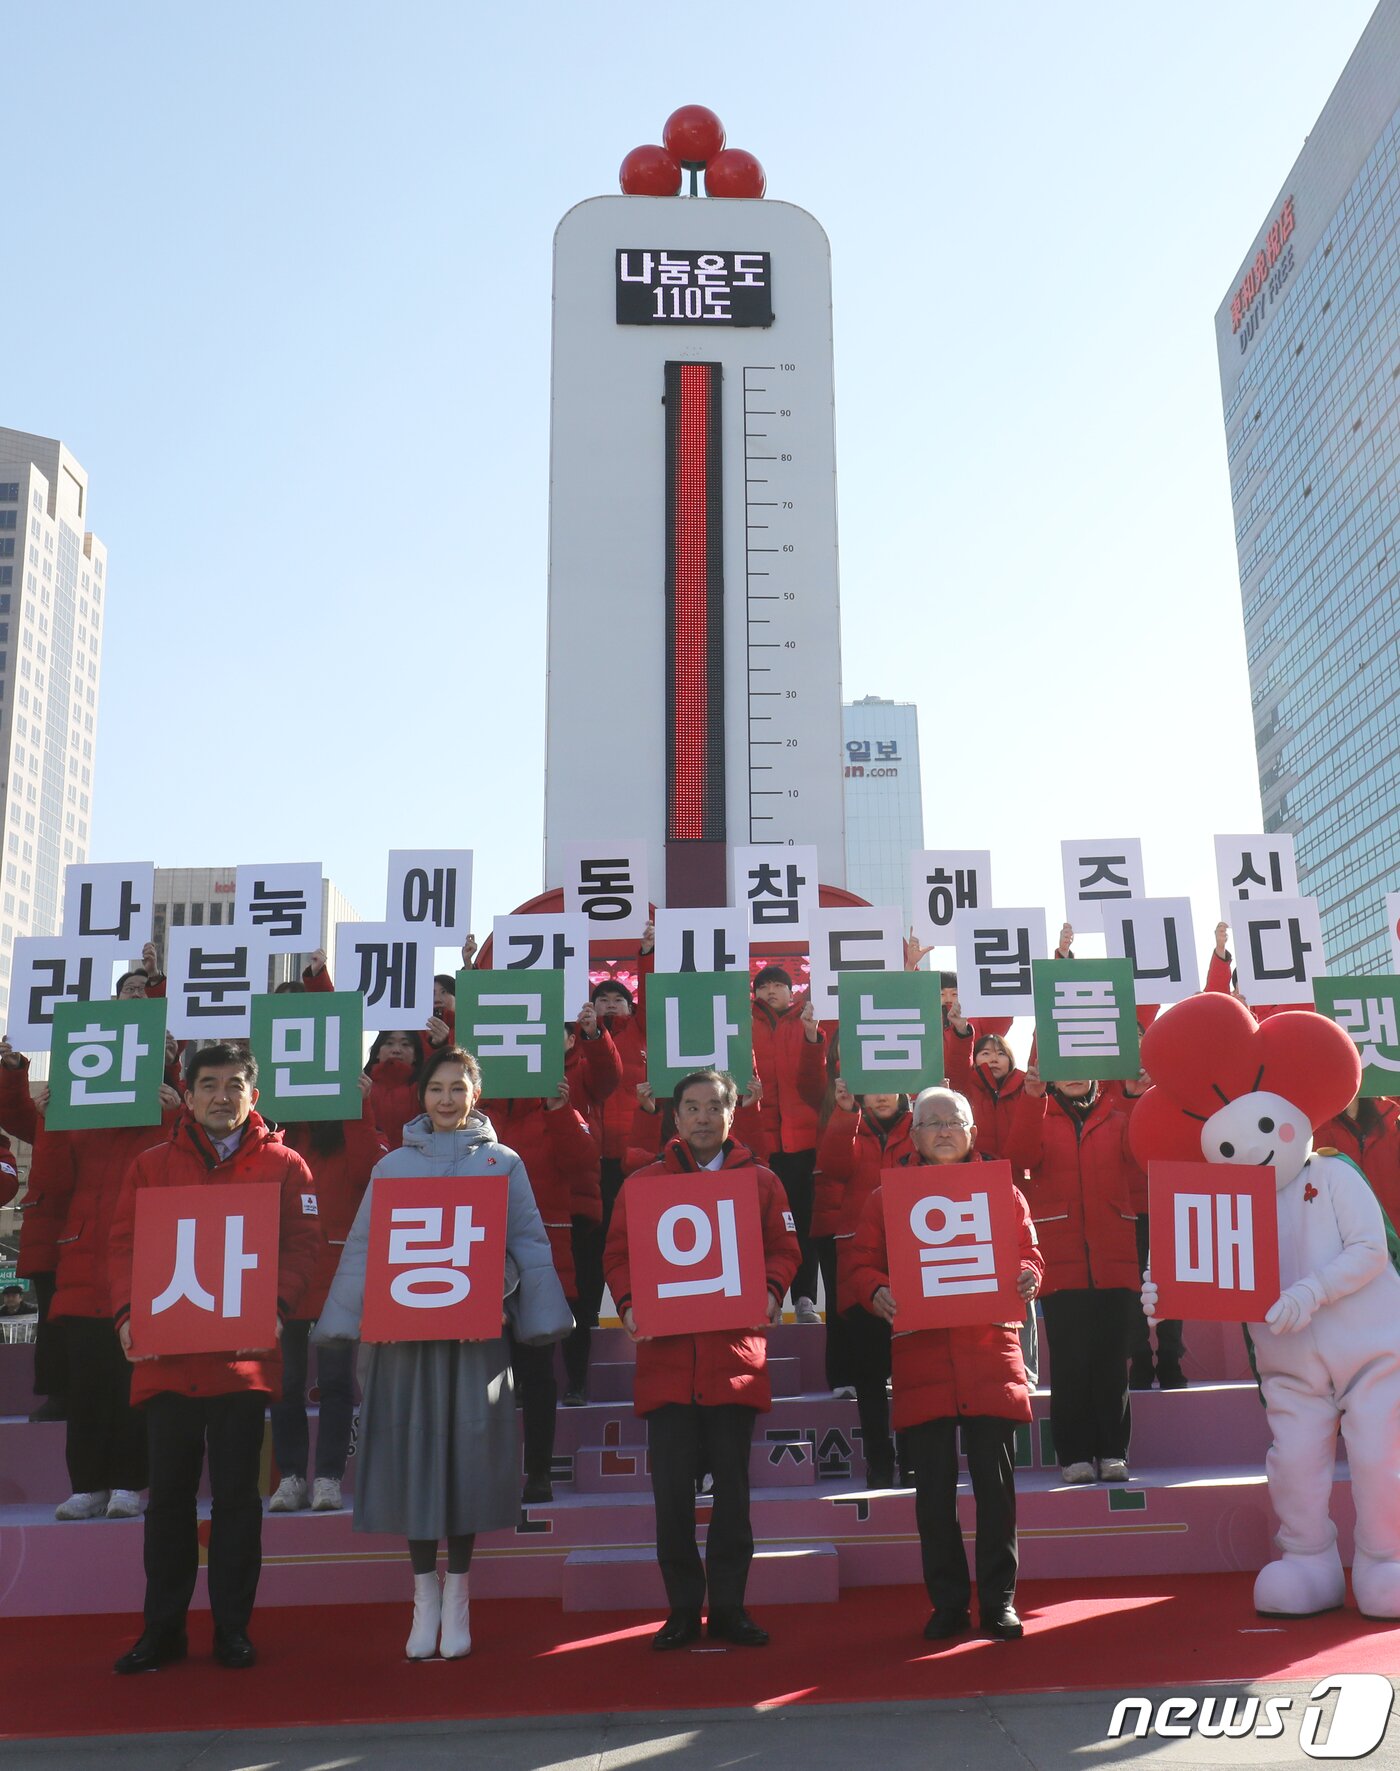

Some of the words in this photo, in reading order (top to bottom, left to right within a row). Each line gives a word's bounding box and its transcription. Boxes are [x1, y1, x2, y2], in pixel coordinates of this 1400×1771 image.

[620, 252, 765, 286] 나눔온도
[1240, 292, 1266, 356] DUTY
[1269, 243, 1295, 305] FREE
[652, 286, 732, 319] 110도
[780, 363, 796, 371] 100
[780, 409, 791, 417] 90
[781, 453, 792, 462] 80
[782, 501, 794, 510] 70
[782, 544, 794, 553] 60
[783, 592, 795, 601] 50
[784, 640, 796, 649] 40
[785, 690, 797, 699] 30
[786, 739, 798, 747] 20
[846, 740, 902, 762] 일보
[788, 789, 799, 798] 10
[788, 838, 795, 846] 0
[79, 881, 140, 940] 나
[403, 868, 457, 927] 에
[578, 858, 634, 920] 동
[748, 864, 806, 924] 참
[927, 868, 978, 926] 해
[350, 942, 416, 1009] 께
[973, 928, 1032, 996] 립
[1121, 917, 1182, 982] 니
[1248, 918, 1312, 982] 다
[28, 958, 93, 1024] 러
[184, 946, 250, 1017] 분
[473, 994, 547, 1073] 국
[665, 994, 739, 1071] 나
[856, 994, 926, 1071] 눔
[1051, 981, 1120, 1057] 플
[68, 1023, 149, 1106] 한
[271, 1016, 341, 1098] 민
[151, 1215, 258, 1318] 사
[388, 1205, 485, 1309] 랑
[656, 1199, 742, 1299] 의
[909, 1192, 998, 1298] 열
[1174, 1193, 1255, 1291] 매
